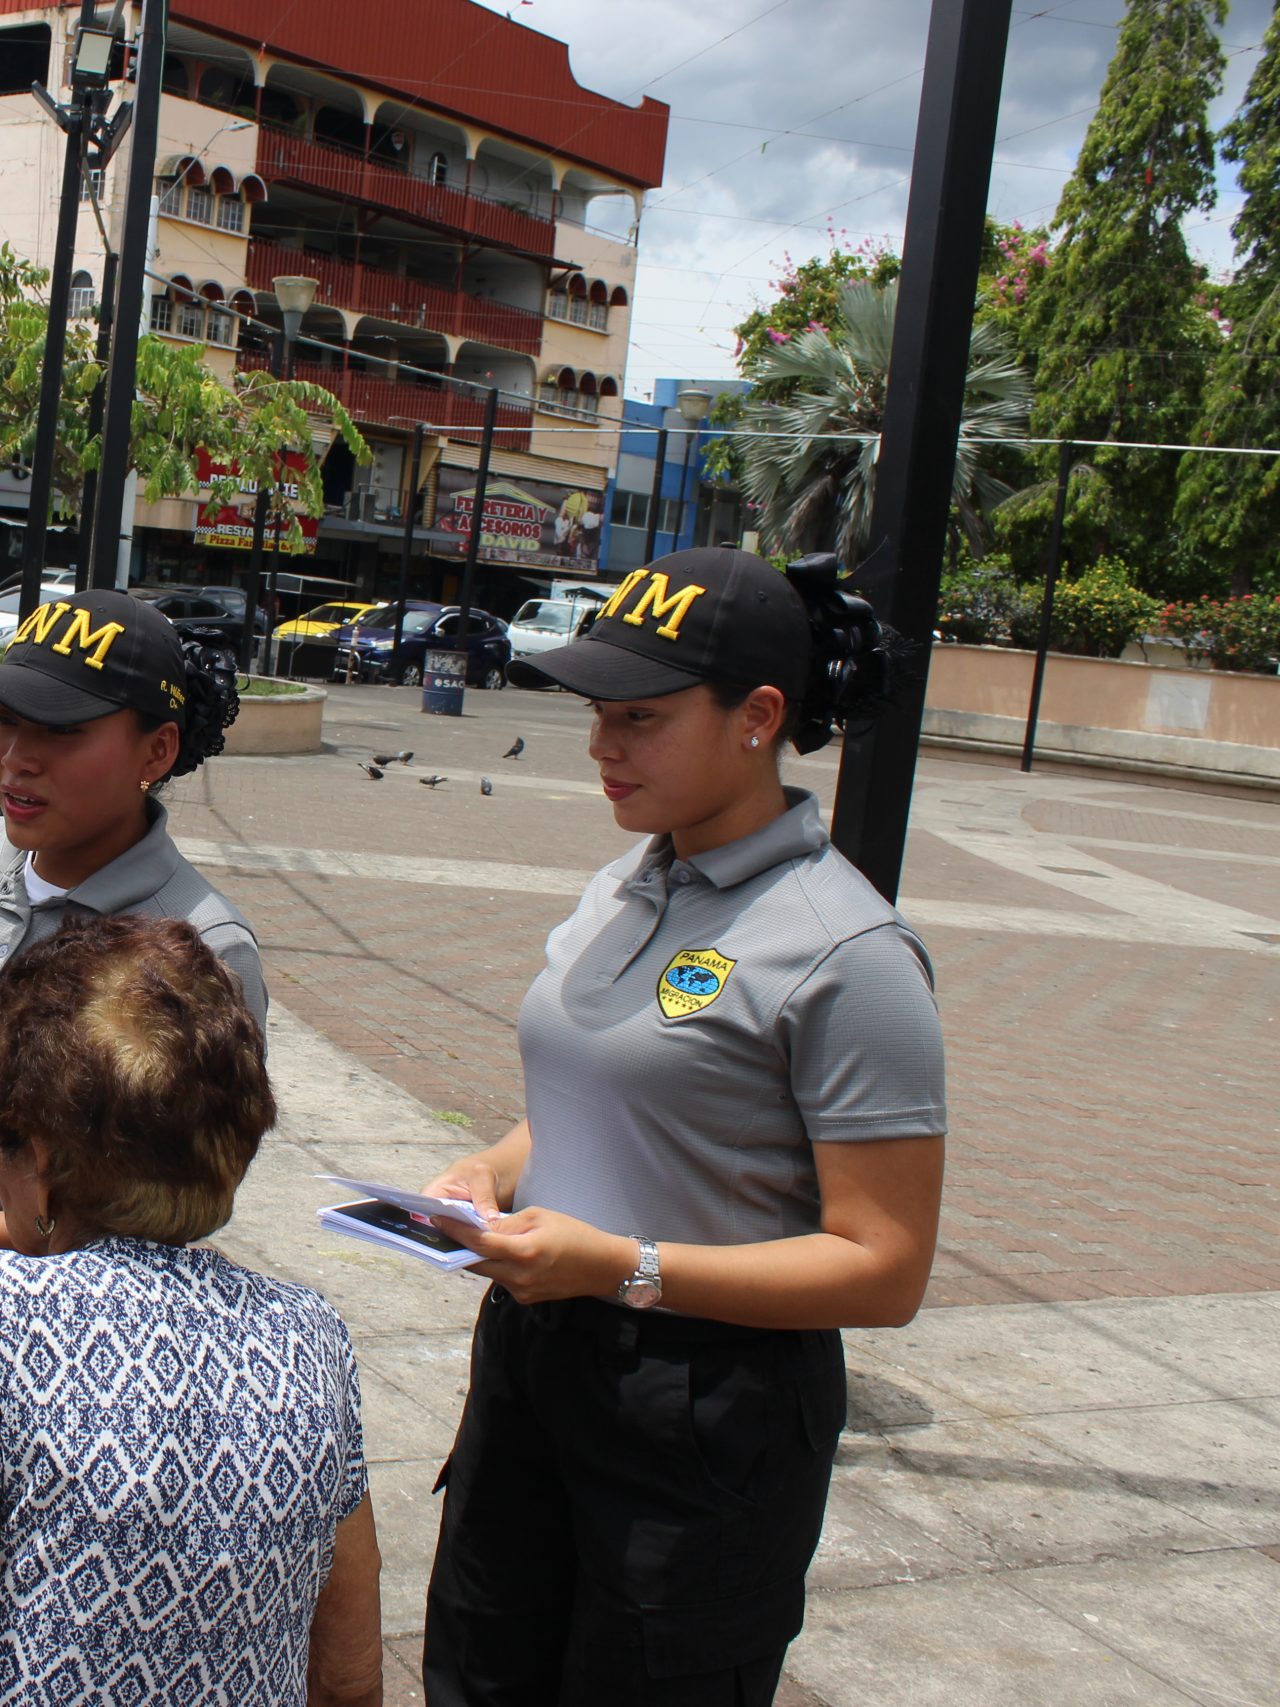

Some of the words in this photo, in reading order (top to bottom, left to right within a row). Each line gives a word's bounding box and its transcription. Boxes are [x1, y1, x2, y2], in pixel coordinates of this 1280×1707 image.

[455, 496, 535, 521] FERETERIA
[480, 533, 540, 551] DAVID
[5, 602, 125, 670] NM
[680, 952, 728, 971] PANAMA
